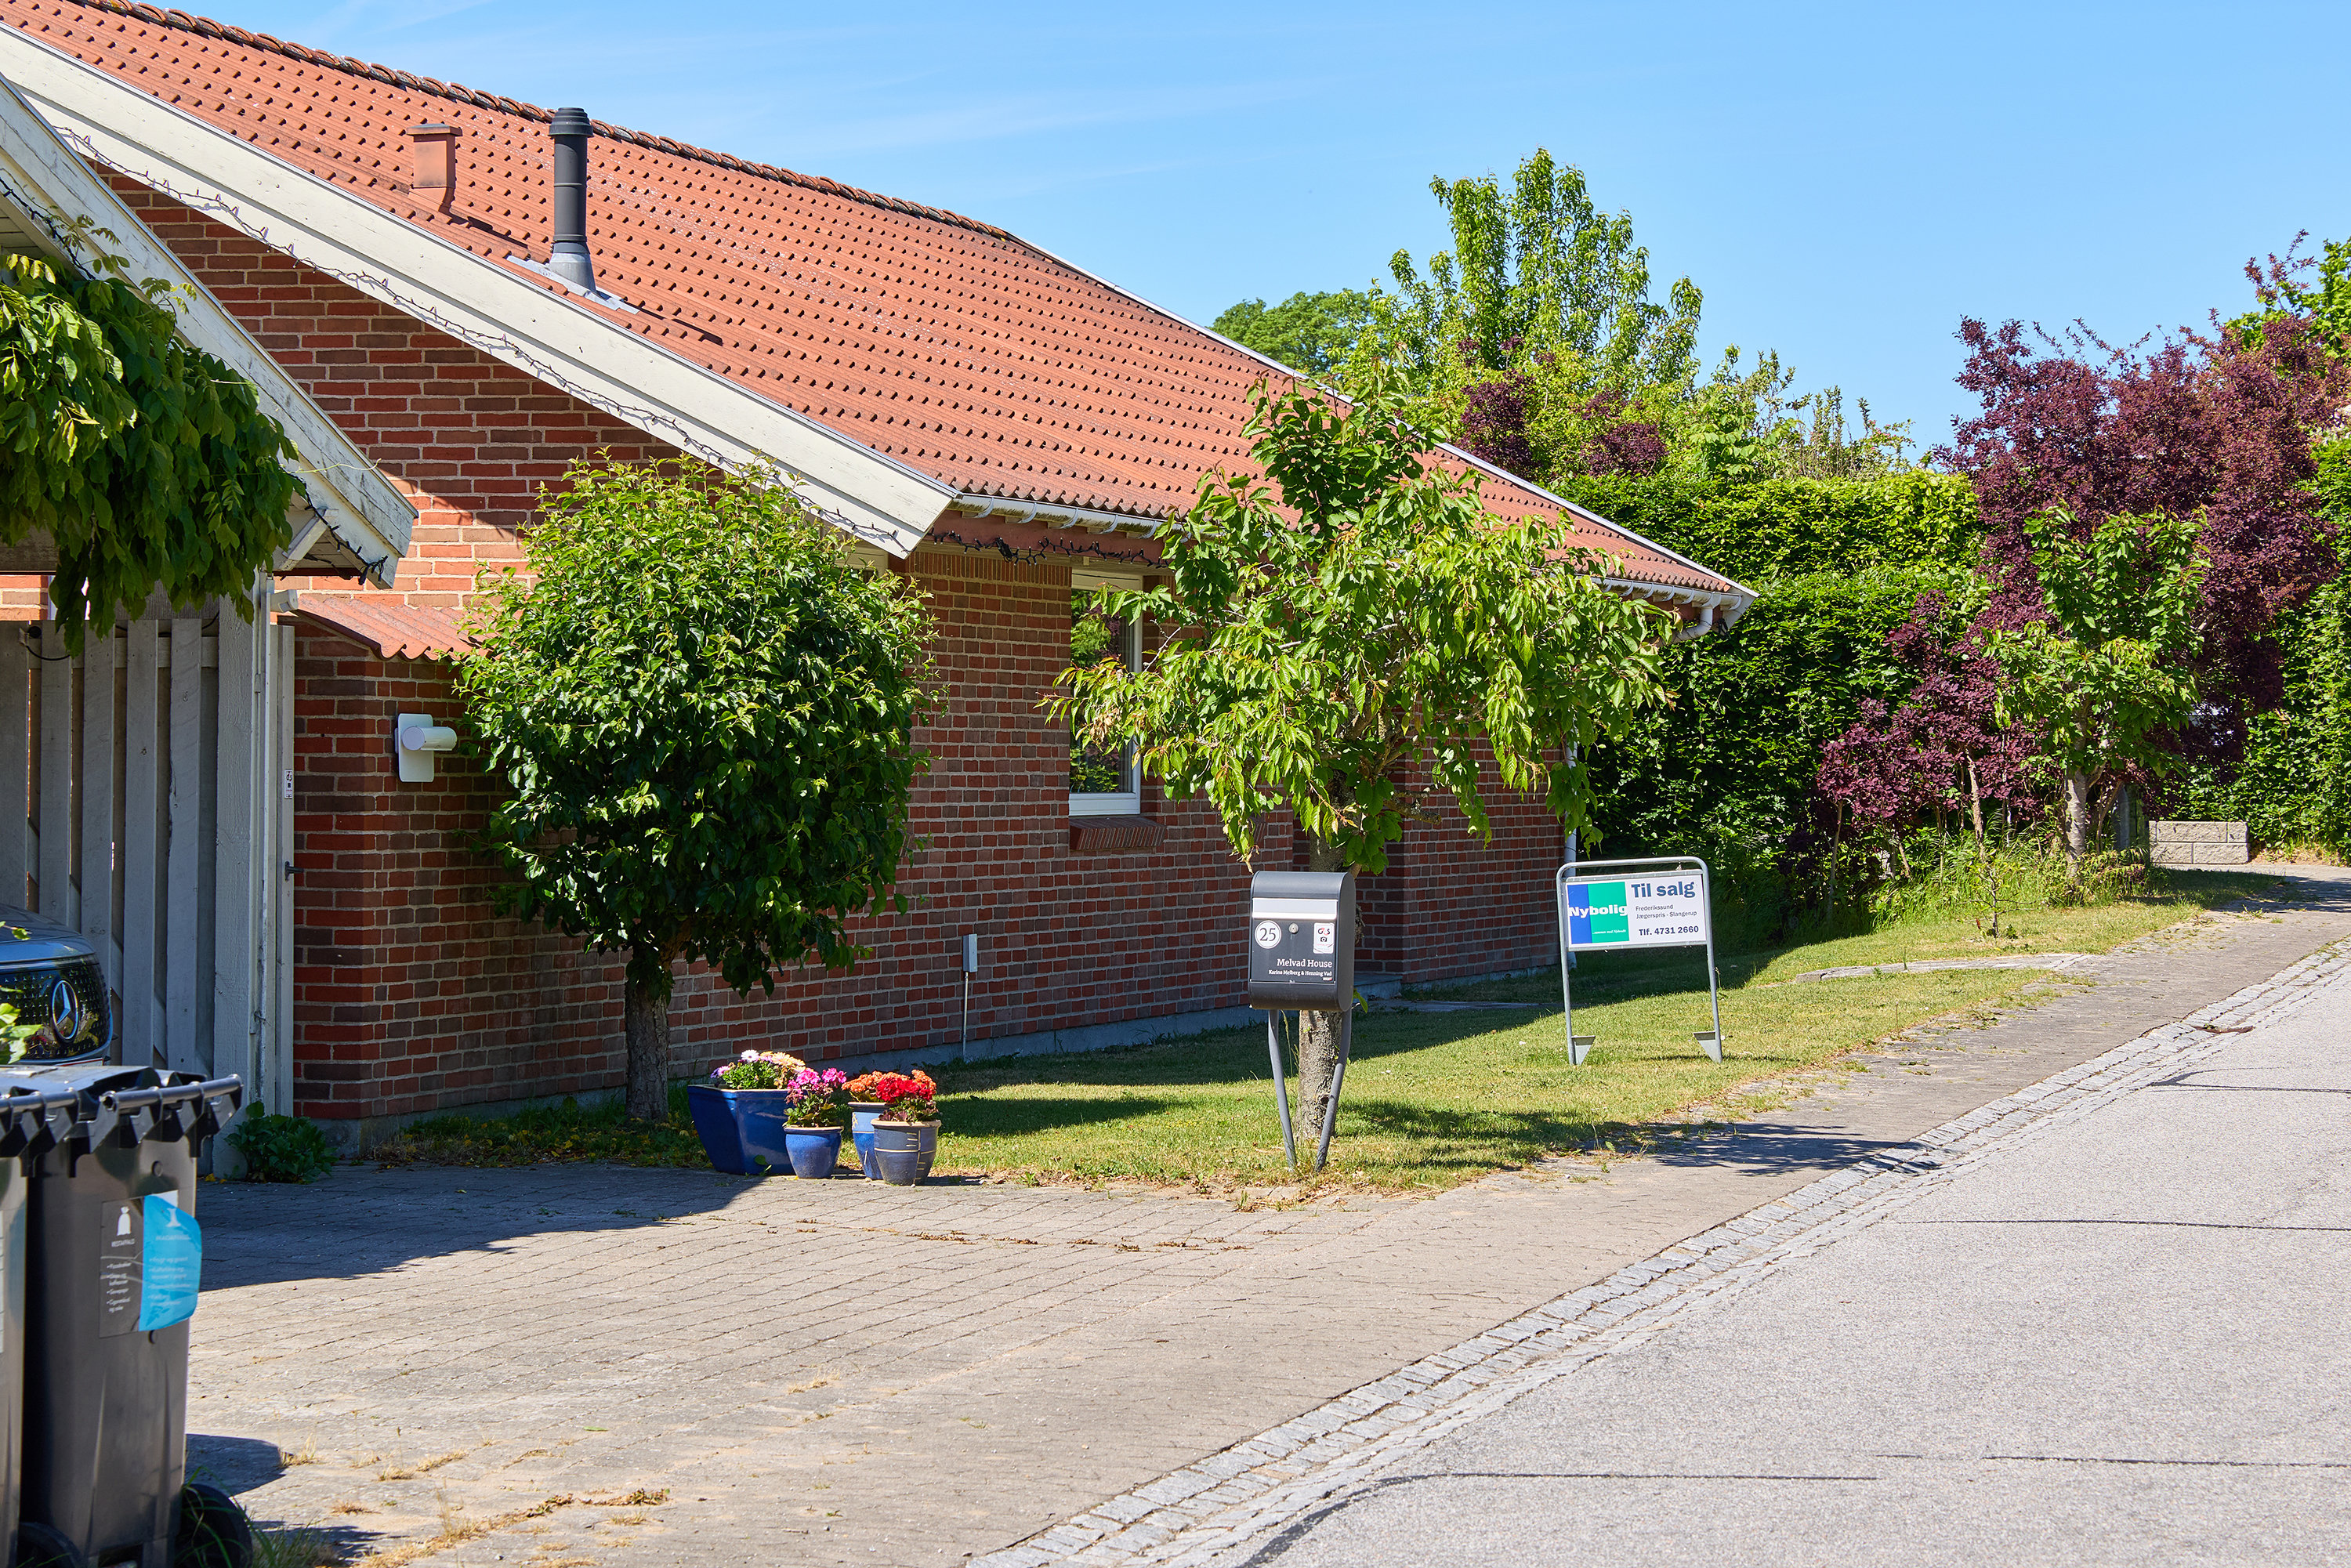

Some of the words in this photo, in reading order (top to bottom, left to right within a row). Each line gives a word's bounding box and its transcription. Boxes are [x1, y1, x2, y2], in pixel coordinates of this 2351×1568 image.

[1631, 883, 1651, 898] Til
[1657, 881, 1696, 898] salg
[1568, 904, 1628, 918] Nybolig
[1259, 927, 1277, 941] 25
[1654, 926, 1675, 935] 4731
[1677, 925, 1699, 934] 2660
[1277, 958, 1306, 967] Melvad
[1307, 959, 1333, 968] House
